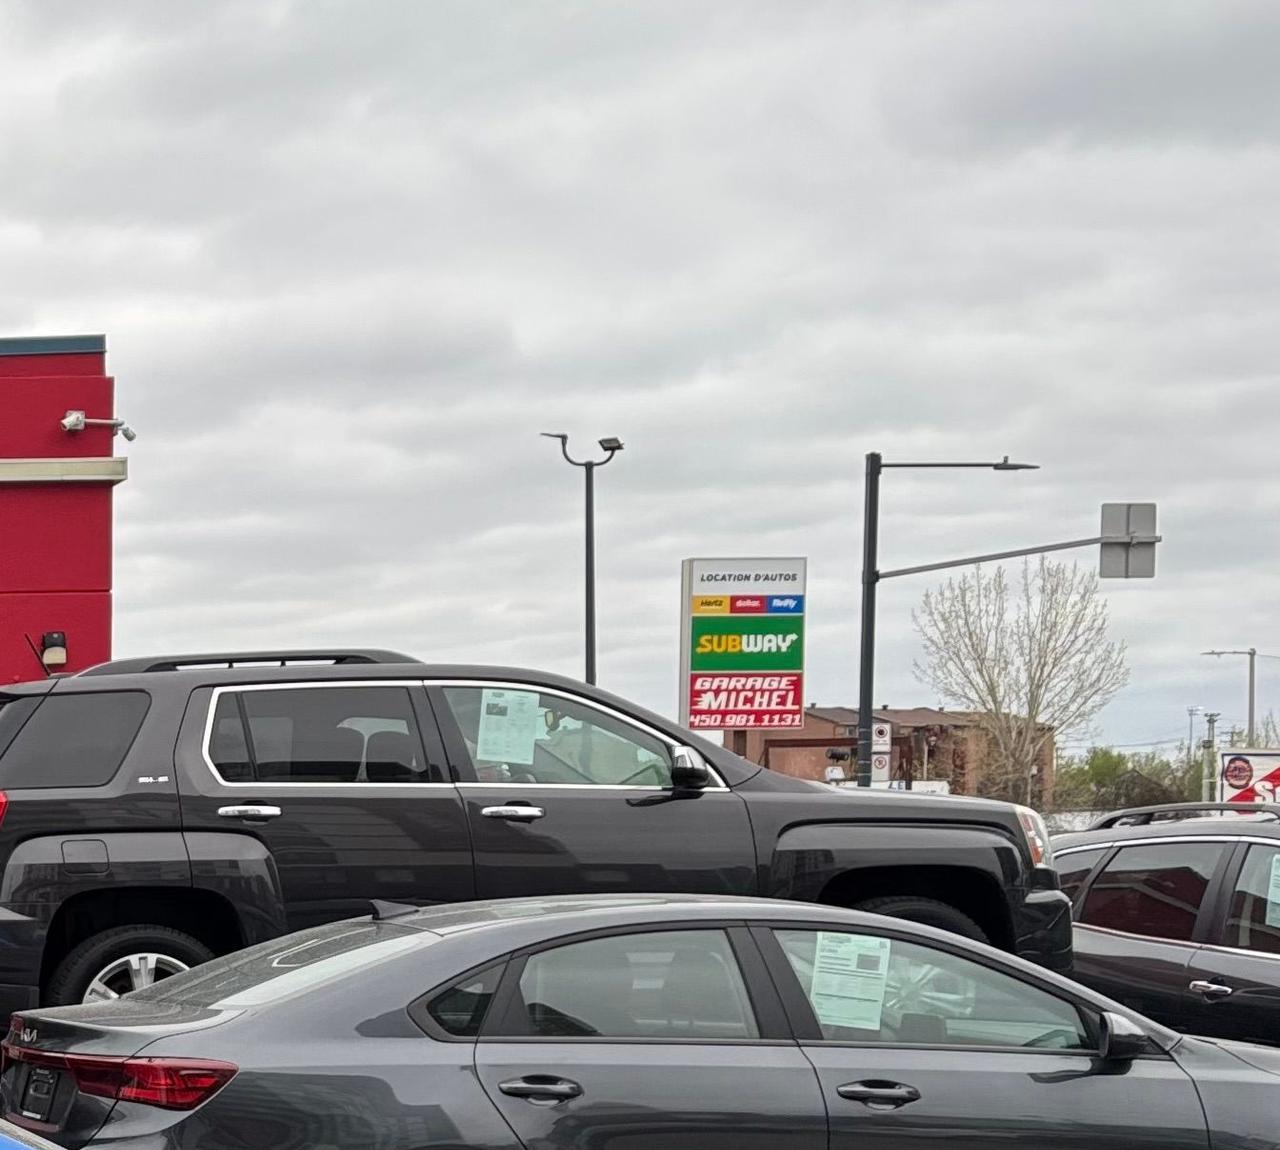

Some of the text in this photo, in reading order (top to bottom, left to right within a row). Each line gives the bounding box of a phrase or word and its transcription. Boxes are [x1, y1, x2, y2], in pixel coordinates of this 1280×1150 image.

[700, 573, 798, 582] LOCATION D'AUTOS
[695, 633, 799, 653] SUBWAY
[694, 676, 798, 690] GARAGE
[696, 690, 800, 710] MICHEL
